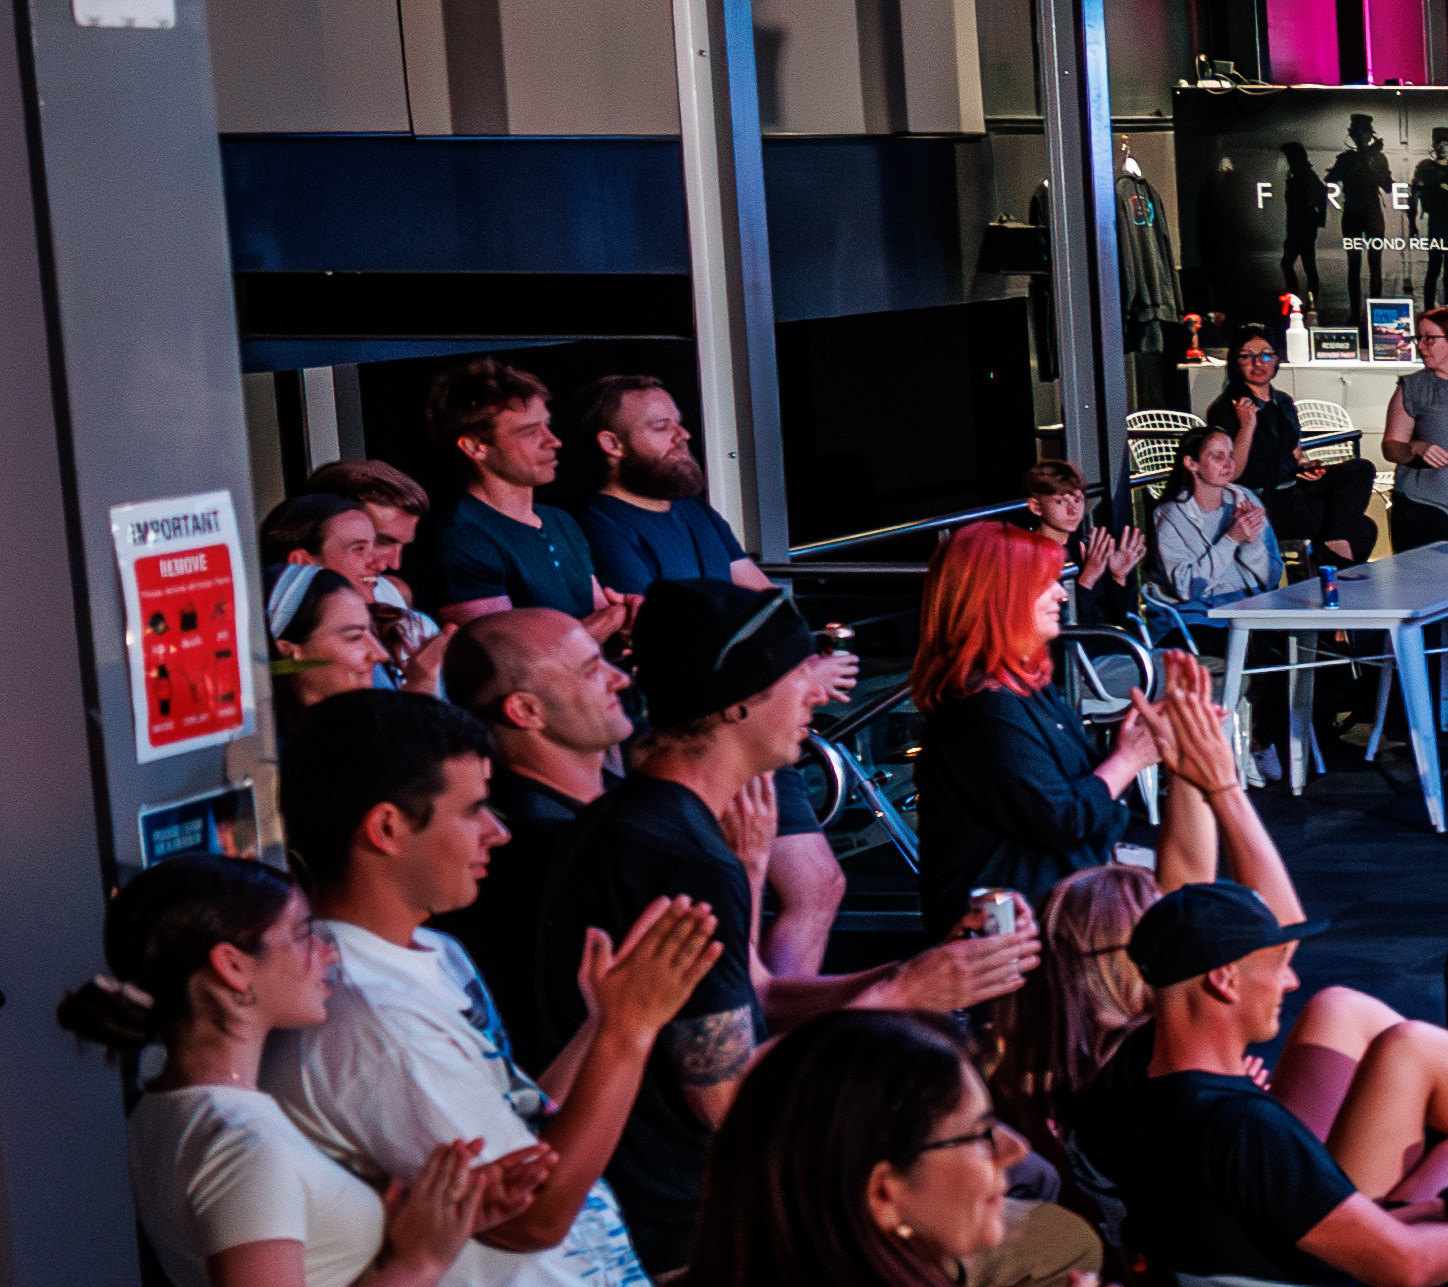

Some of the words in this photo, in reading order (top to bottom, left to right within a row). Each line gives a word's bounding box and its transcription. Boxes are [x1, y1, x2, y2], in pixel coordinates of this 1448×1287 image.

[1343, 238, 1405, 251] BEYOND
[131, 510, 220, 545] IMPORTANT
[159, 553, 209, 578] REMOVE
